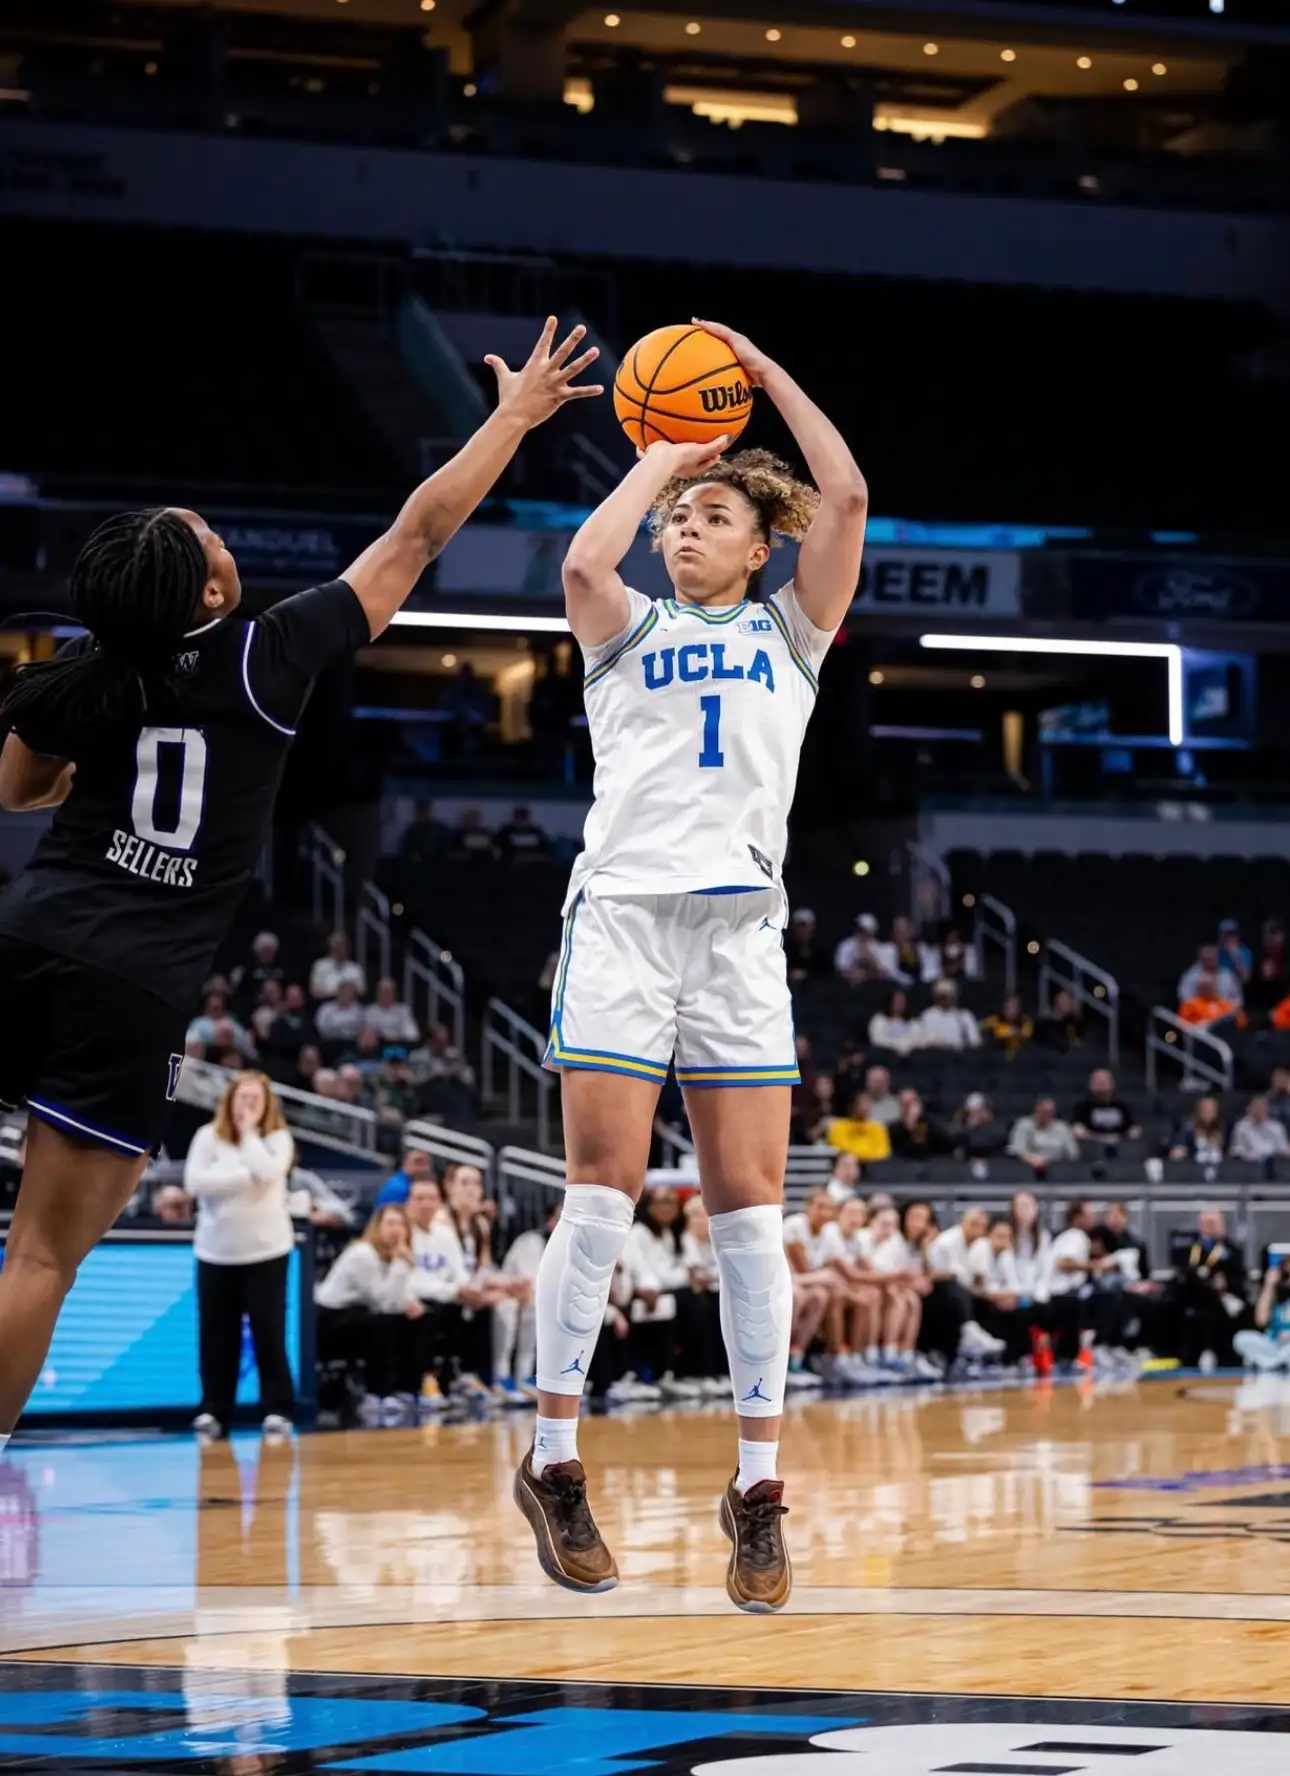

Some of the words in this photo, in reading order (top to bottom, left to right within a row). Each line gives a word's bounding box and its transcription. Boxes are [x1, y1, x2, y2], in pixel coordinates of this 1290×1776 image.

[698, 380, 752, 413] Wils
[641, 643, 775, 694] UCLA
[698, 694, 724, 768] 1
[131, 726, 207, 850] 0
[106, 828, 198, 888] SELLERS
